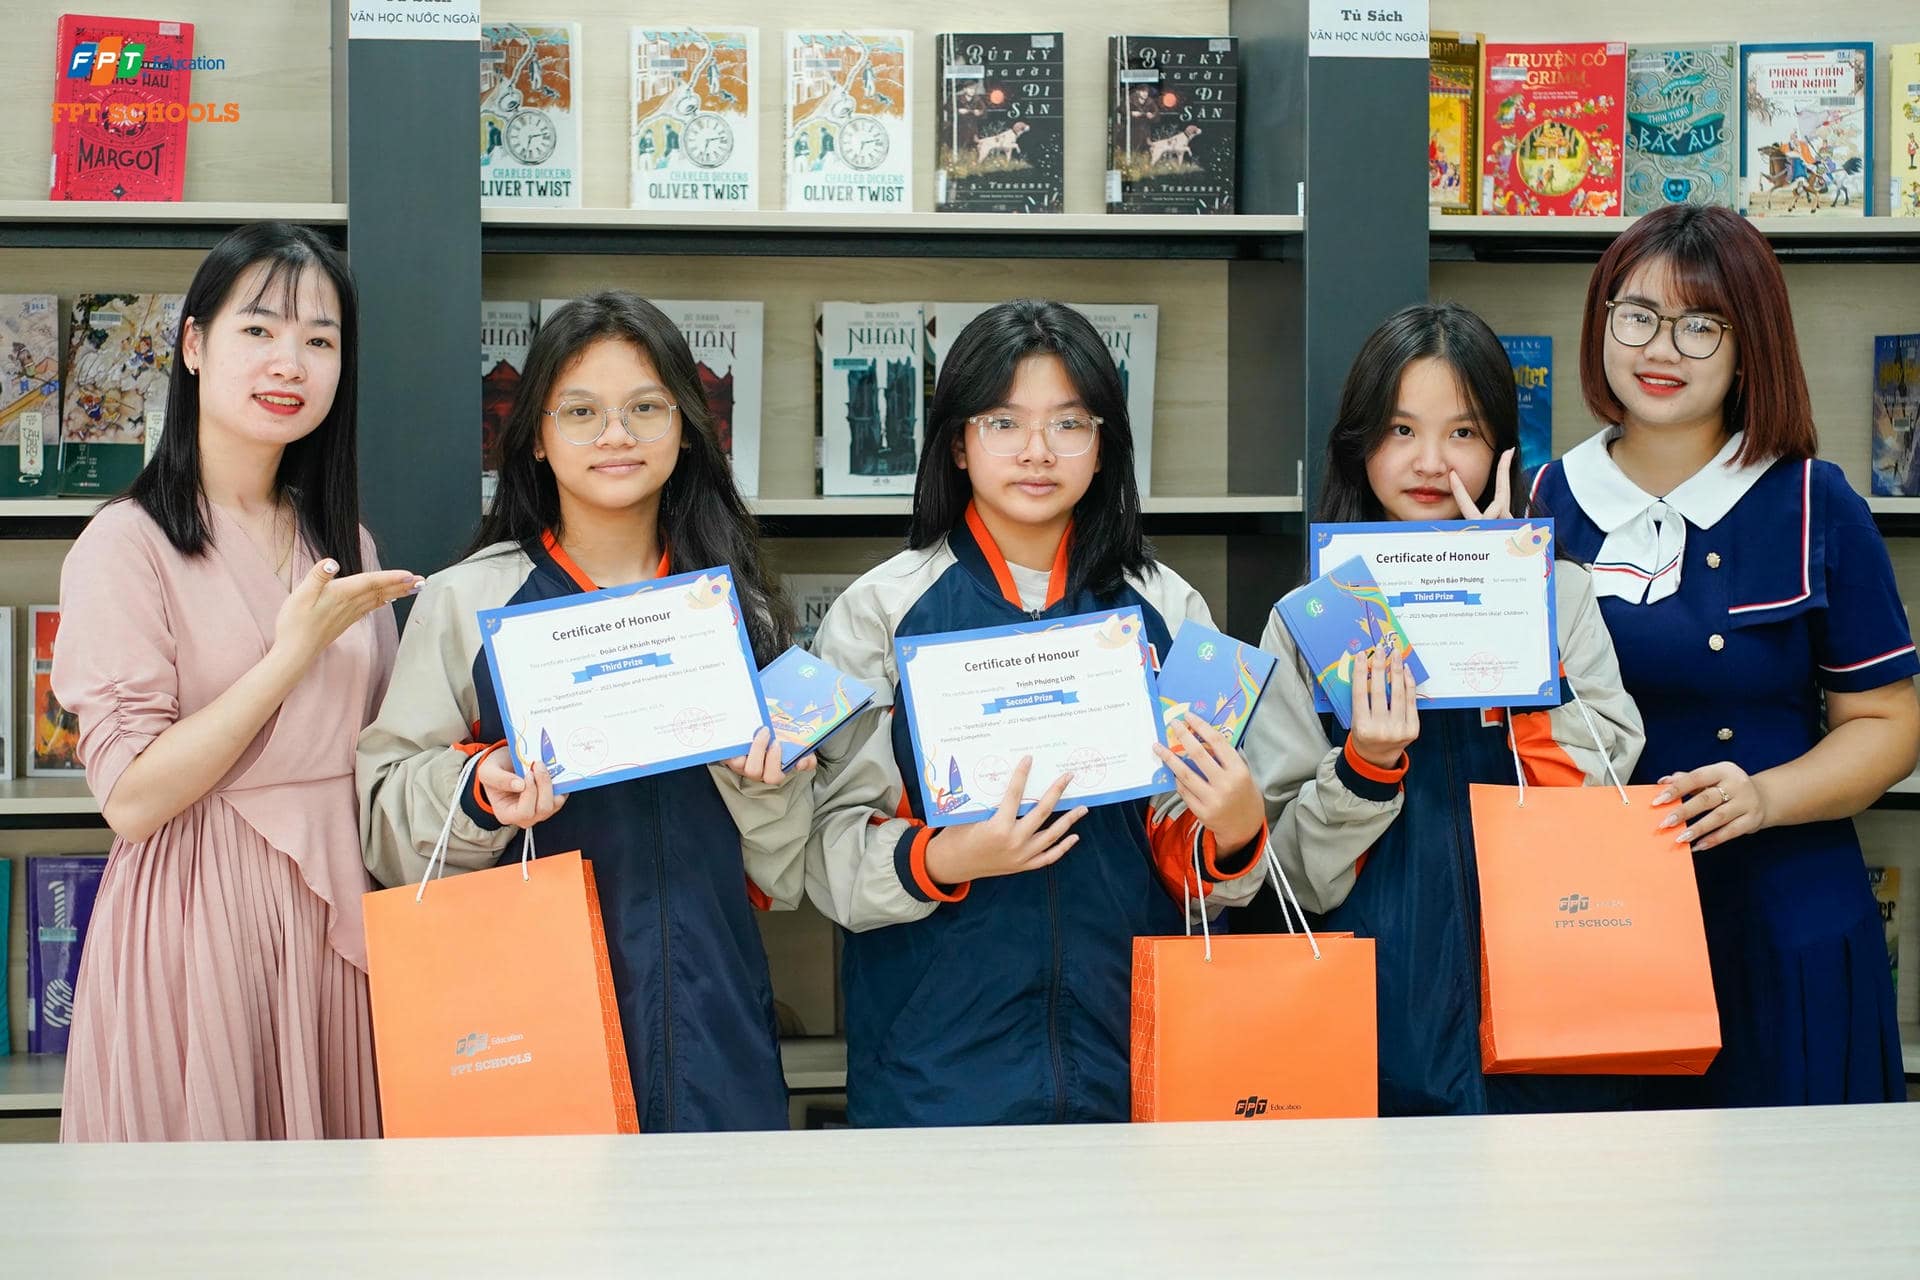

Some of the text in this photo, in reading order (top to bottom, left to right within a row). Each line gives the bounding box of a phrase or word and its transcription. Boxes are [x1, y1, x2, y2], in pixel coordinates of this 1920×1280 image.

[350, 10, 480, 24] VĂN HỌC NƯỚC NGOÀI
[1340, 9, 1403, 21] Tủ Sách
[1310, 29, 1428, 42] VĂN HỌC NƯỚC NGOÀI
[966, 44, 1012, 65] BÚT
[1139, 47, 1186, 68] BÚT
[1506, 46, 1607, 70] TRUYỆN CỔ
[1526, 71, 1586, 86] GRIMM
[1769, 68, 1808, 78] PHONG
[78, 136, 165, 176] MARGOT
[492, 168, 571, 179] CHARLES DICKENS
[481, 180, 571, 197] LIVER TWIST
[649, 183, 749, 200] OLIVER TWIST
[804, 185, 905, 202] OLIVER TWIST
[1376, 551, 1490, 564] Certificate of Honour
[552, 609, 672, 641] Certificate of Honour
[601, 657, 643, 673] Third Prize
[964, 649, 1080, 673] Certificate of Honour
[1061, 674, 1076, 684] Linh
[1006, 692, 1054, 706] Second Prize
[1555, 918, 1632, 928] FPT SCHOOLS
[475, 1053, 532, 1072] SCHOOLS
